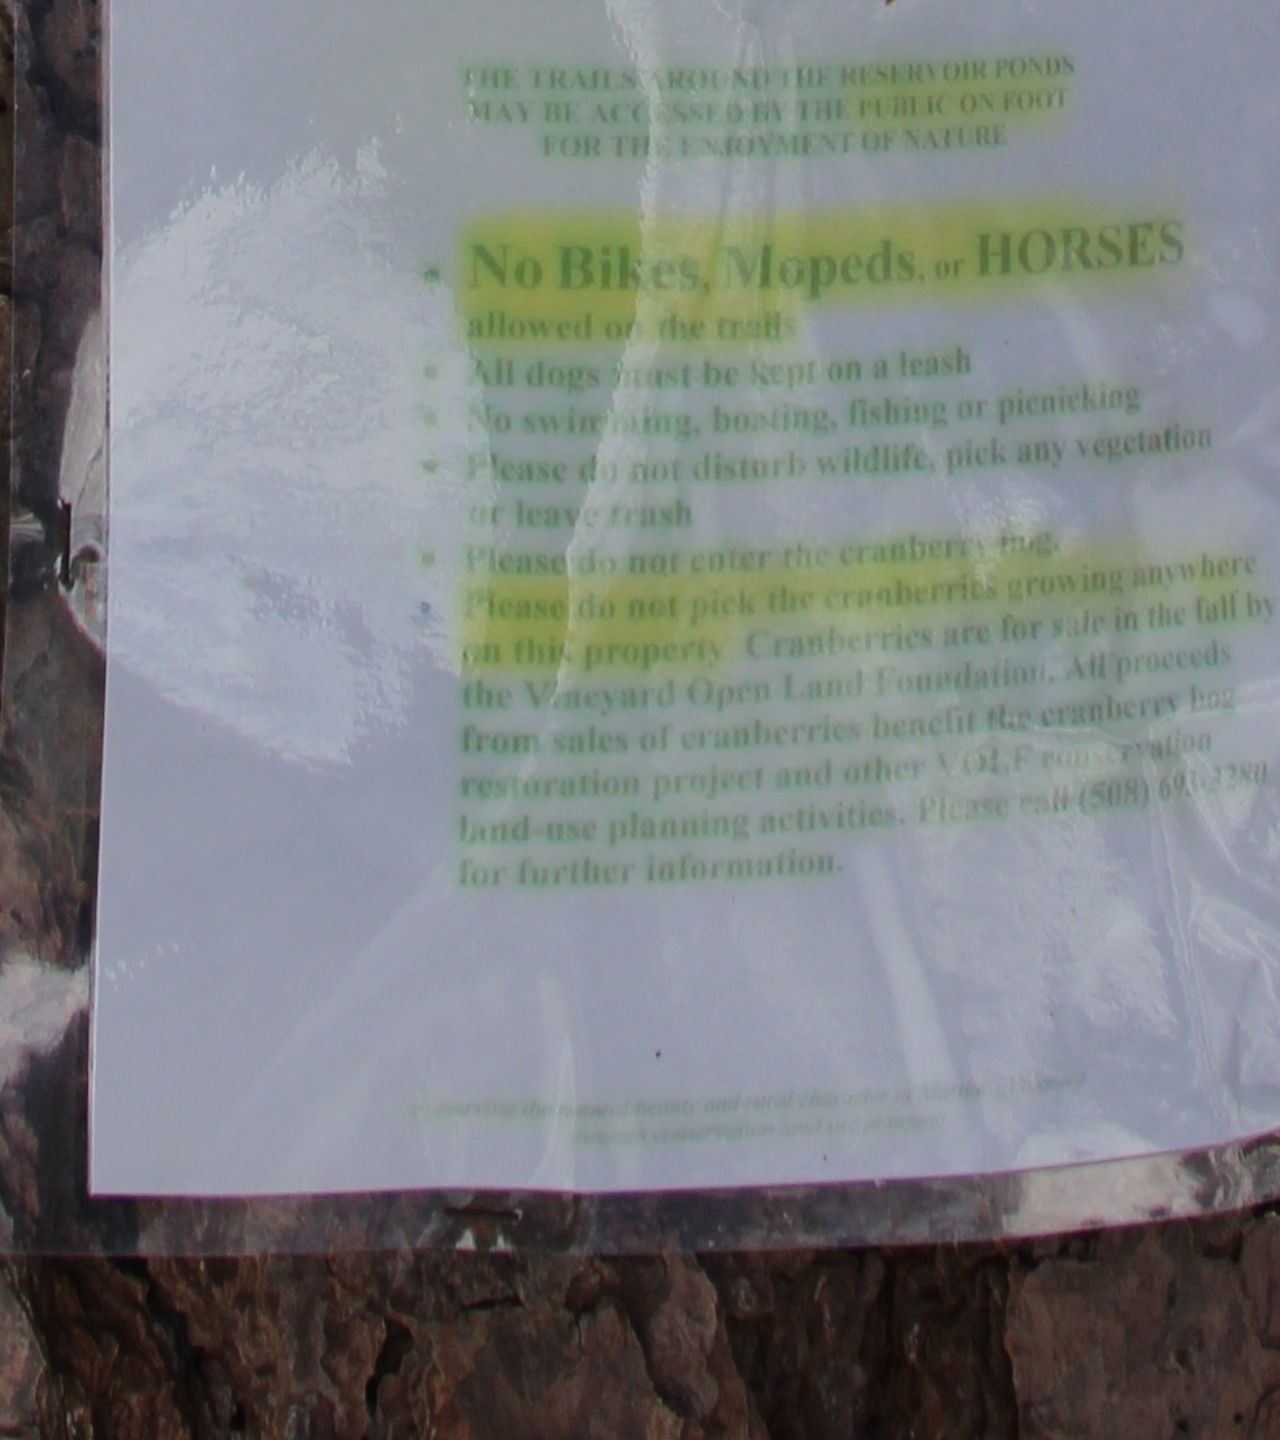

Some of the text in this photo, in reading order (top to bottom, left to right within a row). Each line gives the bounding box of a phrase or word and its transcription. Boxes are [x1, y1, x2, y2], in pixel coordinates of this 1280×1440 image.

[528, 55, 1075, 91] TRAILS RESERVOIR PONDS
[801, 88, 1070, 120] THE PUBLIC ON FOOT
[543, 124, 1007, 157] FOR NATURE
[470, 220, 1184, 299] No Bikes, Mopeds, or HORSES
[468, 311, 592, 340] allowed
[526, 347, 971, 393] dogs be on leash
[849, 397, 948, 428] fishing
[956, 399, 989, 420] or
[998, 381, 1141, 426] picnicking
[467, 452, 567, 482] Please
[631, 455, 682, 481] not
[692, 450, 808, 481] disturb
[946, 437, 1007, 475] pick
[1017, 438, 1067, 468] any
[1075, 422, 1212, 460] vegetation
[466, 545, 567, 575] Please
[628, 549, 680, 574] not
[690, 548, 772, 573] enter
[464, 552, 1256, 625] Please do not pick the cranberries growing anywhere
[514, 591, 1277, 664] this Cranberries are for the fall by
[462, 680, 512, 709] the
[687, 676, 770, 711] Open
[783, 668, 863, 700] Land
[1116, 639, 1231, 673] proceeds
[461, 693, 1177, 755] from sales of cranberries benefit cranberry
[461, 753, 920, 800] restoration project and other
[459, 794, 1011, 847] land-use planning activities. Please
[460, 848, 843, 886] for further information.
